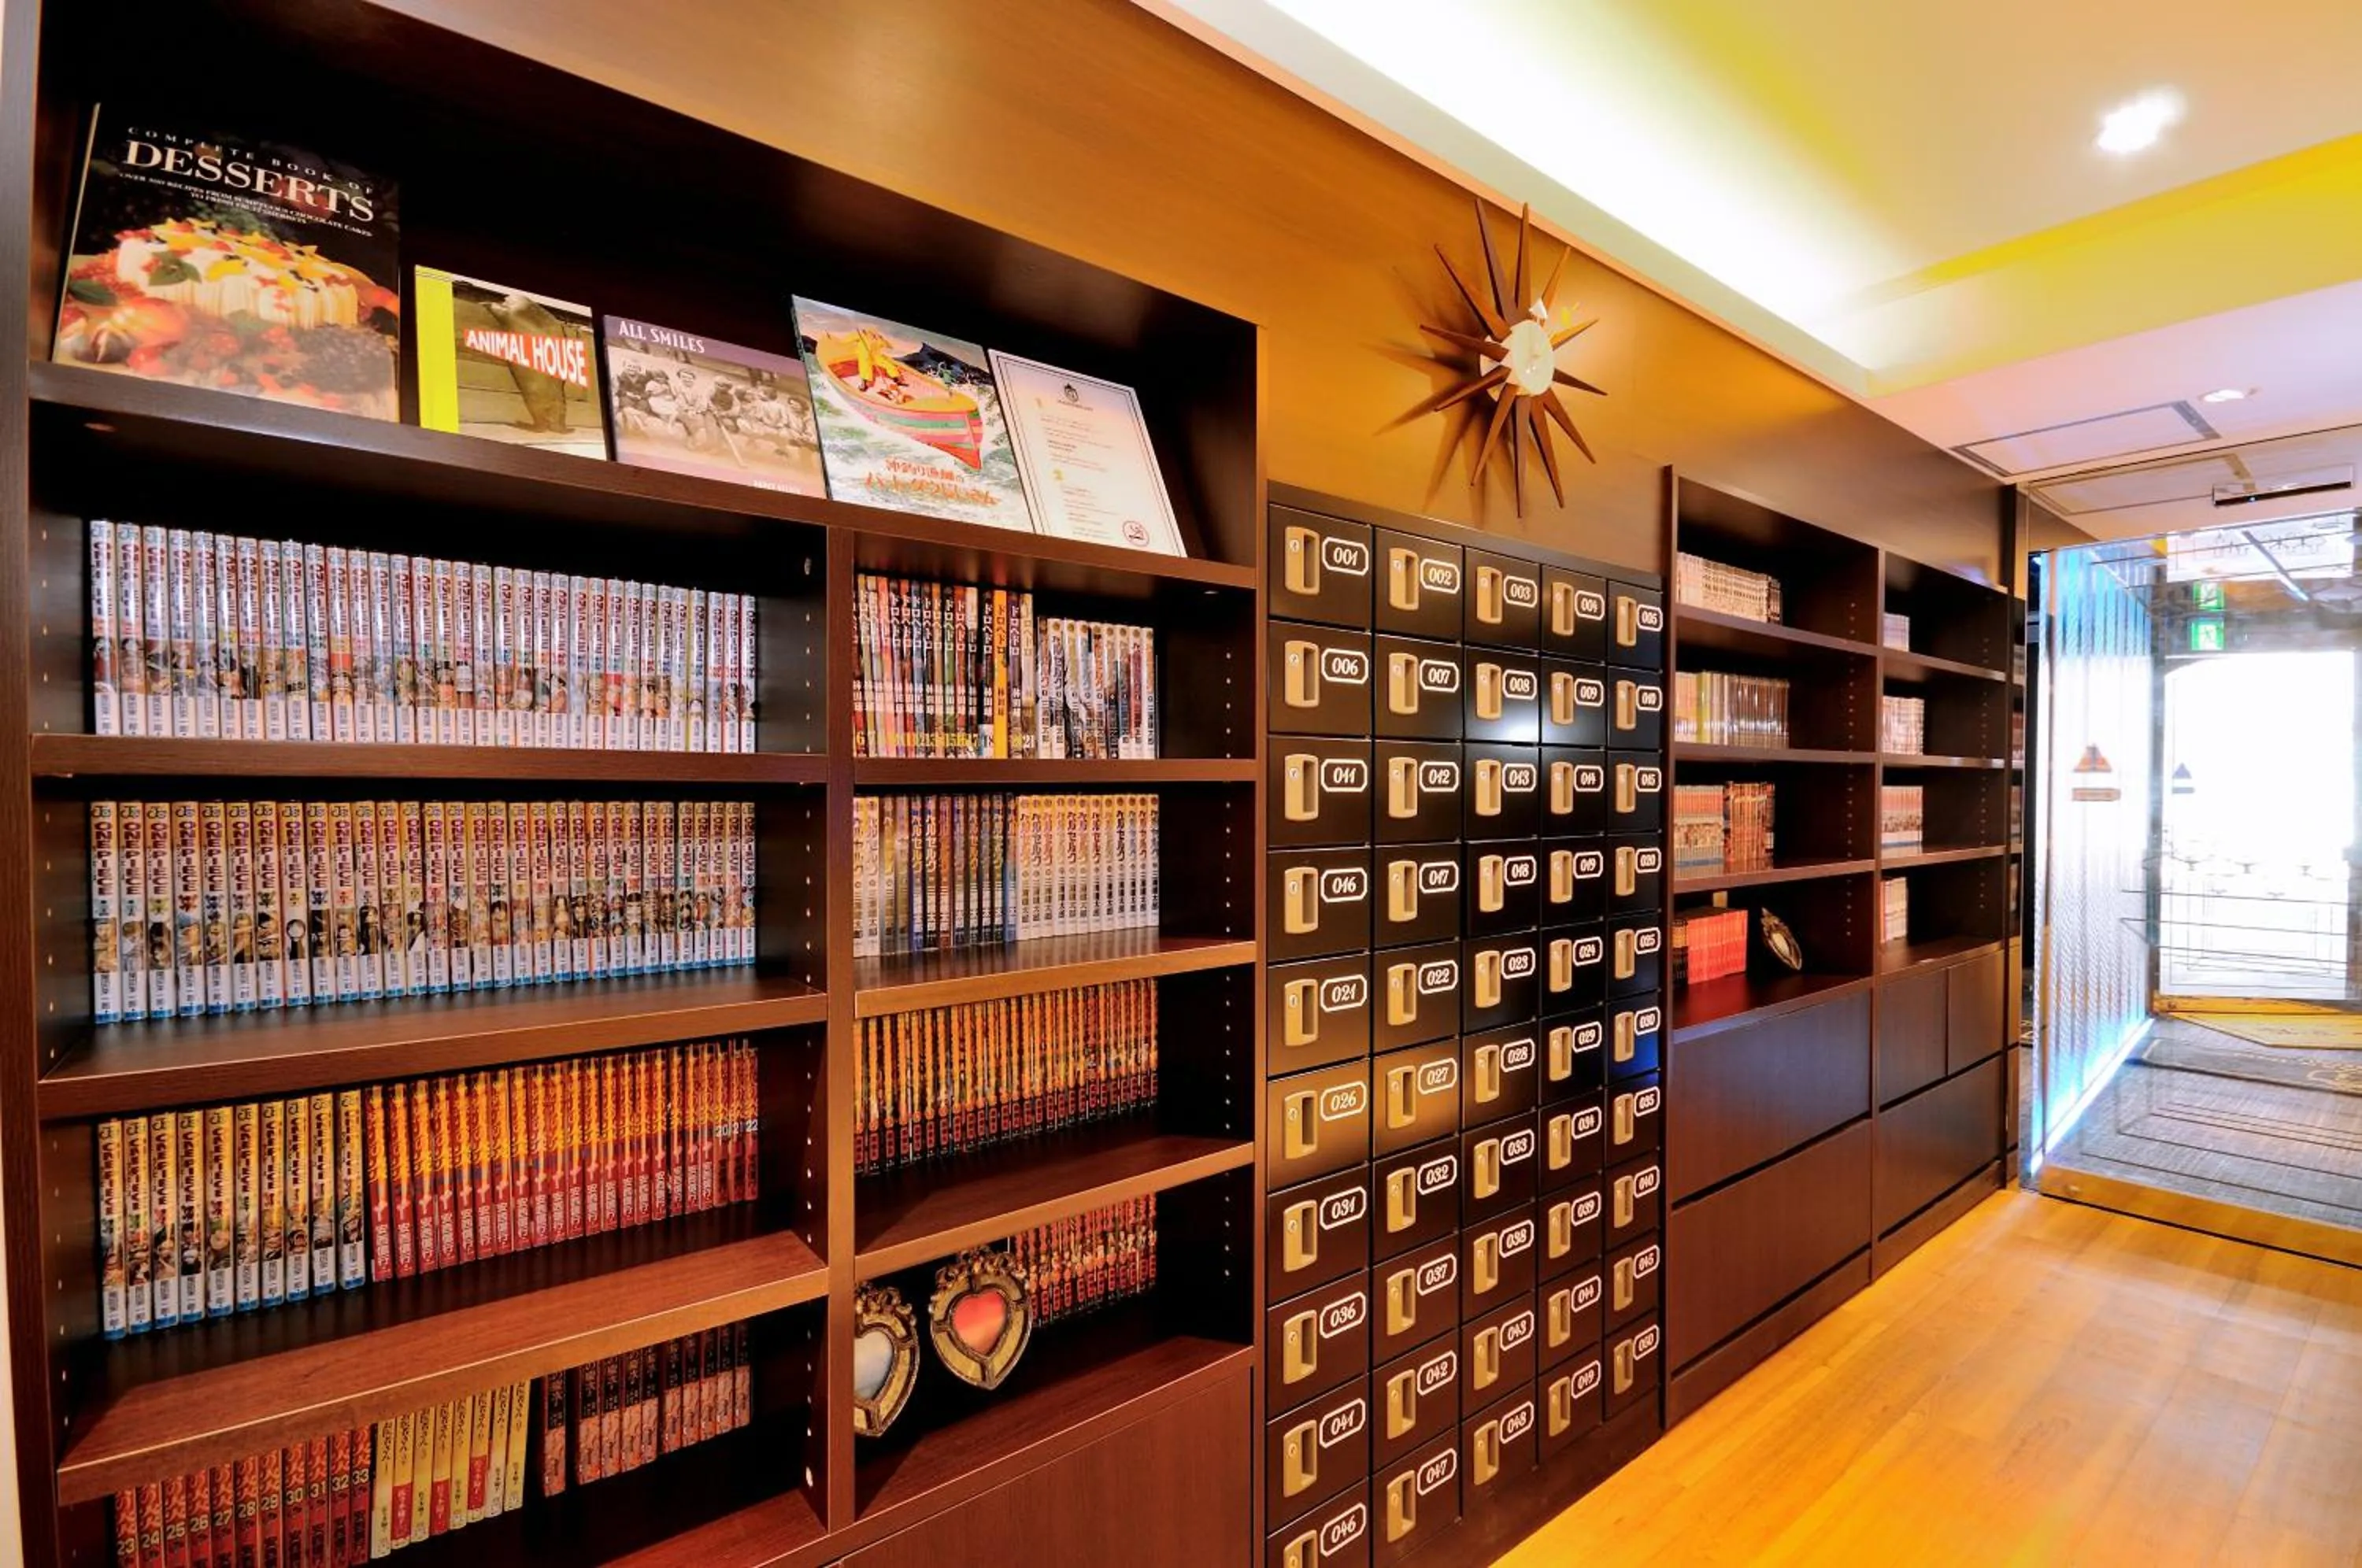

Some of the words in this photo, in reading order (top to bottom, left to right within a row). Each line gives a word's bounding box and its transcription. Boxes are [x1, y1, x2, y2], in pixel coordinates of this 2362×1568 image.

[128, 127, 254, 160] COMPLETE
[272, 158, 333, 182] BOOK
[349, 182, 373, 194] OF
[122, 139, 374, 222] DESSERTS
[619, 320, 646, 340] ALL
[651, 327, 705, 353] SMILES
[465, 330, 530, 367] ANIMAL
[532, 336, 588, 387] HOUSE
[1333, 546, 1359, 567] 001
[1428, 567, 1453, 586] 002
[1509, 582, 1531, 601] 003
[1580, 597, 1598, 613] 004
[1331, 656, 1359, 676] 006
[1427, 667, 1451, 685] 007
[1509, 676, 1531, 693] 008
[1579, 685, 1598, 701] 009
[1332, 766, 1357, 784] 011
[1428, 768, 1451, 785] 012
[1509, 769, 1530, 786] 013
[1580, 771, 1597, 786] 014
[1511, 862, 1530, 879] 018
[1579, 857, 1597, 872] 019
[1331, 875, 1357, 894] 016
[1428, 868, 1449, 886] 017
[1578, 943, 1597, 960] 024
[1508, 954, 1529, 972] 023
[1426, 967, 1450, 986] 022
[1331, 982, 1357, 1004] 021
[1578, 1028, 1596, 1046] 029
[1507, 1045, 1528, 1065] 028
[1426, 1066, 1449, 1086] 027
[1330, 1090, 1357, 1111] 026
[746, 1119, 757, 1132] 22
[1577, 1114, 1595, 1132] 034
[1507, 1137, 1528, 1157] 033
[1425, 1163, 1449, 1185] 032
[1331, 1196, 1357, 1220] 031
[1576, 1199, 1596, 1219] 039
[1505, 1227, 1527, 1249] 038
[1425, 1263, 1448, 1286] 037
[1577, 1284, 1595, 1304] 044
[1330, 1301, 1357, 1328] 036
[1507, 1319, 1527, 1342] 043
[1425, 1360, 1449, 1385] 042
[1577, 1369, 1595, 1390] 049
[1330, 1409, 1355, 1436] 041
[1506, 1411, 1527, 1434] 048
[352, 1469, 369, 1485] 33
[1425, 1458, 1448, 1485] 047
[310, 1481, 326, 1498] 31
[332, 1474, 349, 1492] 32
[261, 1494, 278, 1511] 29
[286, 1487, 303, 1505] 30
[213, 1509, 232, 1526] 27
[238, 1501, 256, 1518] 28
[166, 1522, 185, 1540] 25
[191, 1514, 209, 1533] 26
[1331, 1514, 1357, 1544] 046
[117, 1537, 135, 1555] 23
[141, 1530, 159, 1548] 24
